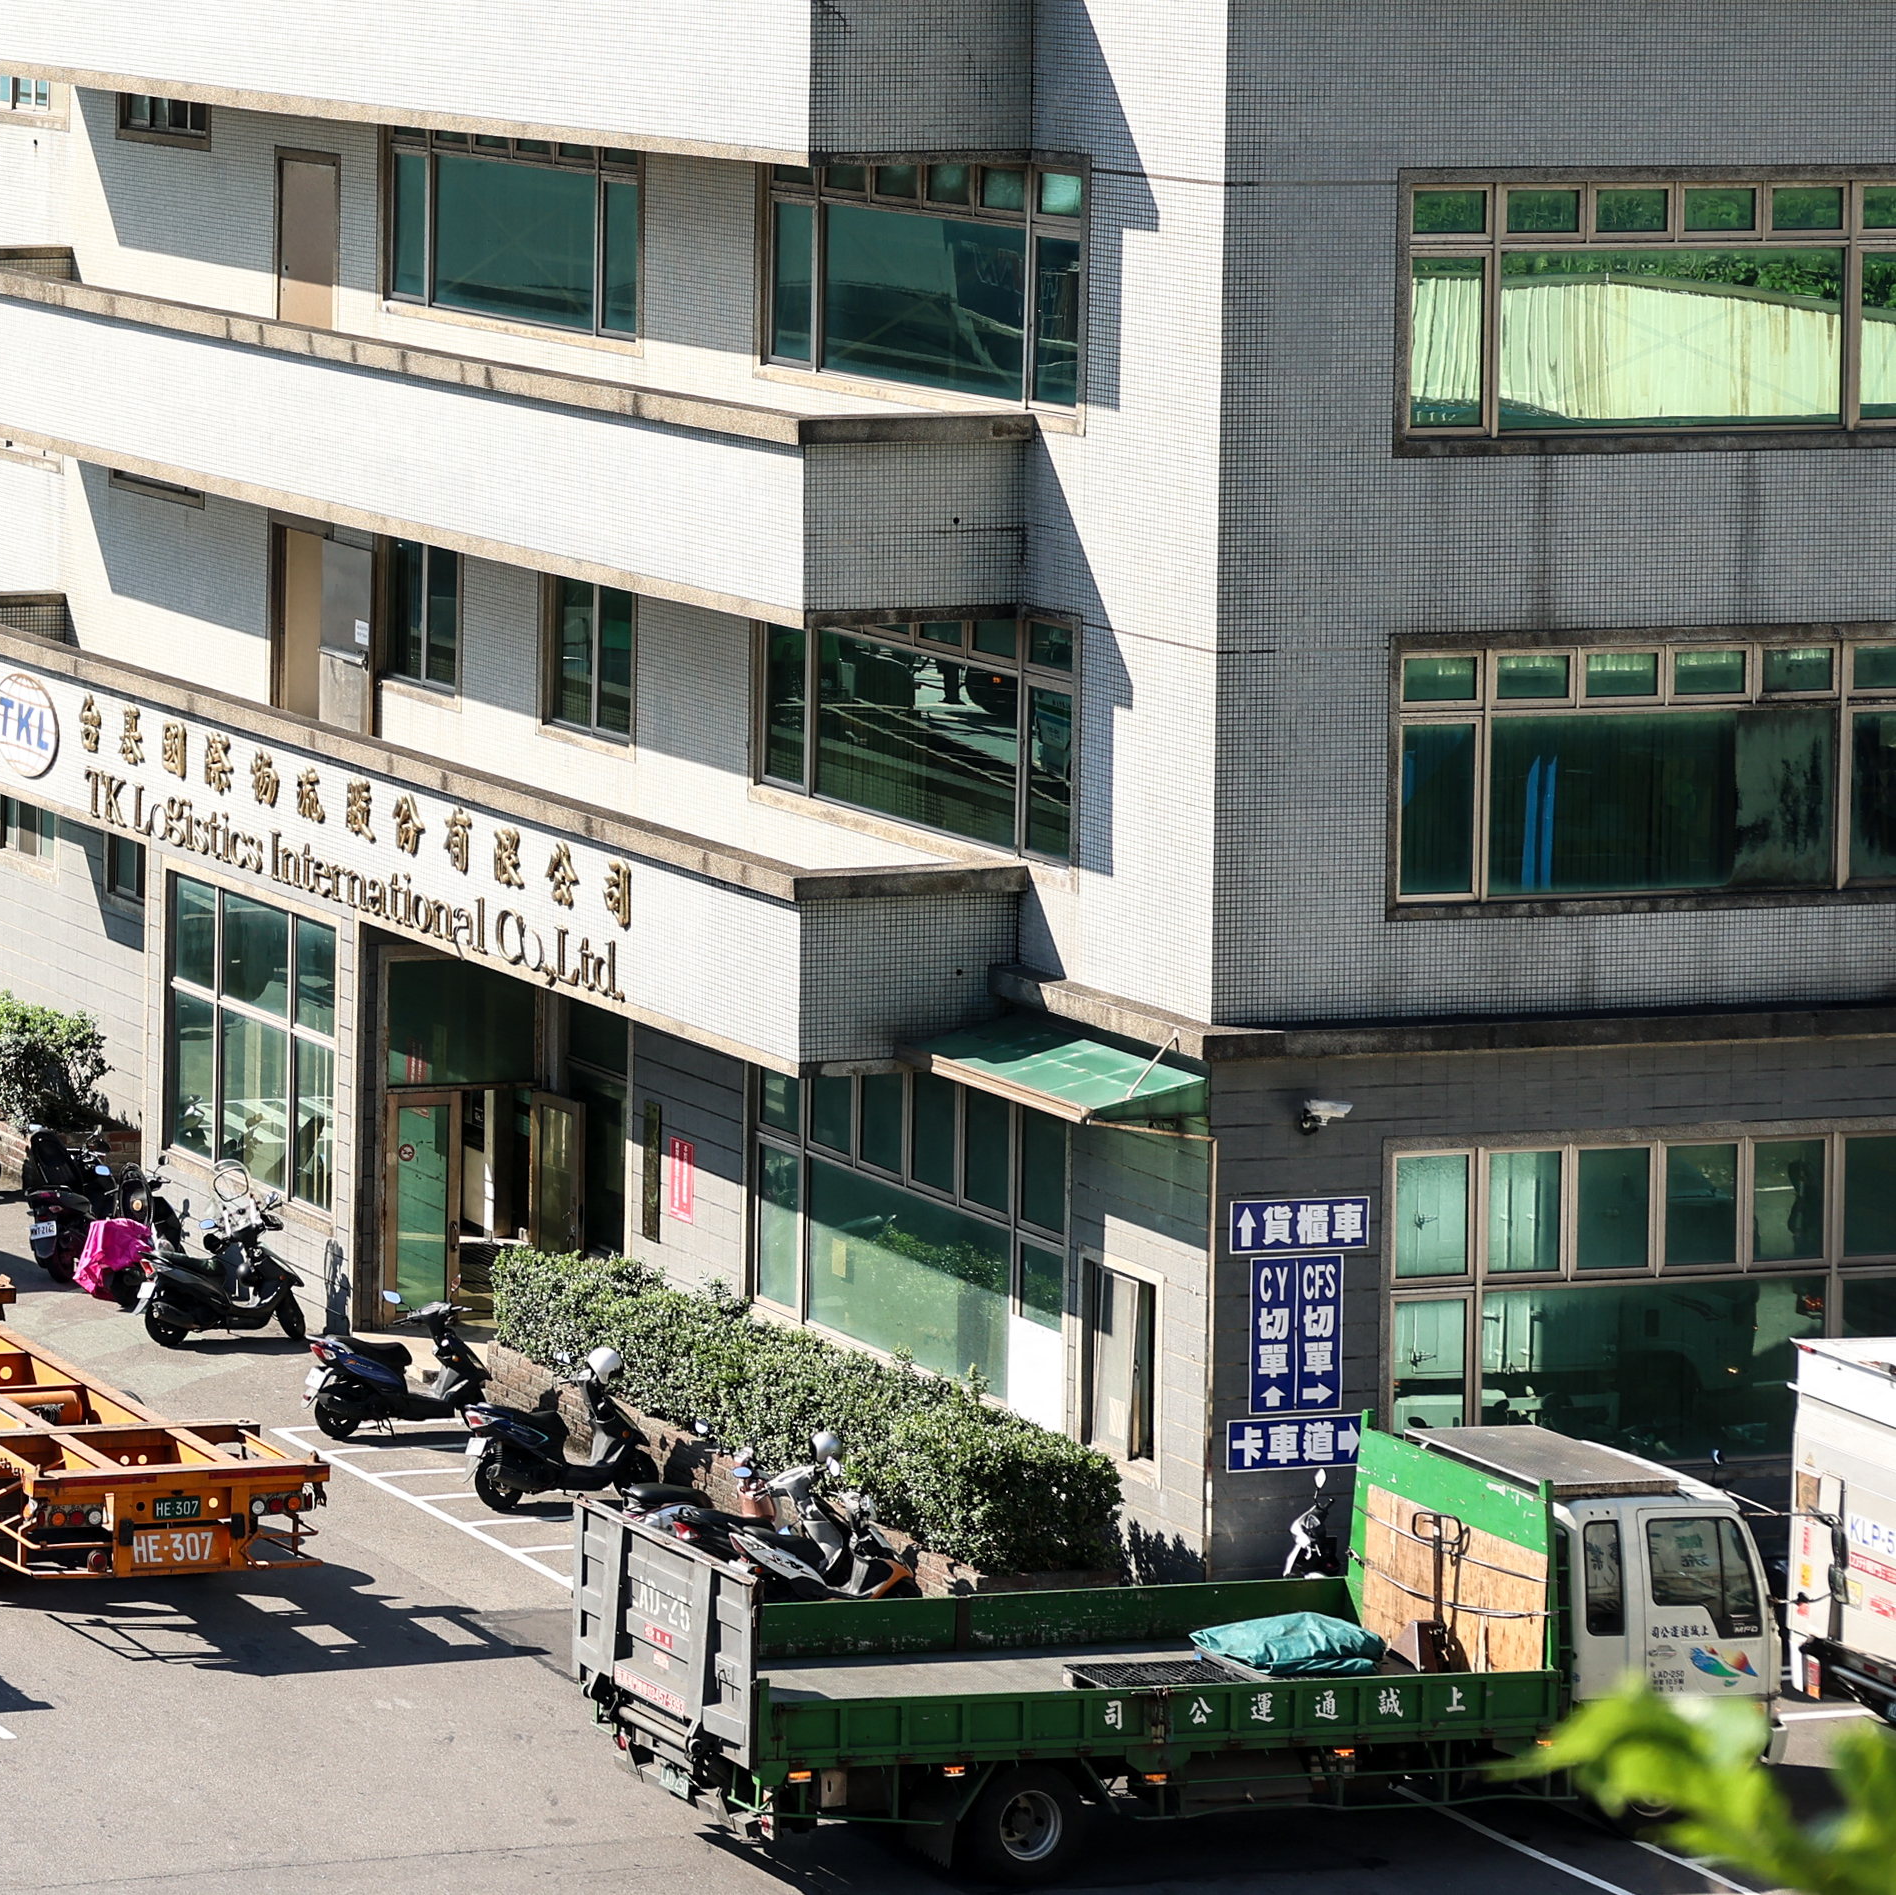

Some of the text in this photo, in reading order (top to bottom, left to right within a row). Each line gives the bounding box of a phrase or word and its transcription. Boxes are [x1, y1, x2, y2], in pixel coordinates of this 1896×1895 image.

[83, 765, 127, 828] TK
[132, 781, 264, 874] Logistics
[269, 827, 489, 961] International
[1262, 1202, 1364, 1246] 貨櫃車
[1257, 1266, 1290, 1379] CY 切單
[1302, 1263, 1336, 1376] CFS 切單
[1231, 1420, 1335, 1468] 卡車道
[155, 1499, 199, 1517] HE-307
[133, 1530, 215, 1564] HE-307
[631, 1574, 693, 1633] LAD-25
[1652, 1670, 1685, 1679] LAD-250
